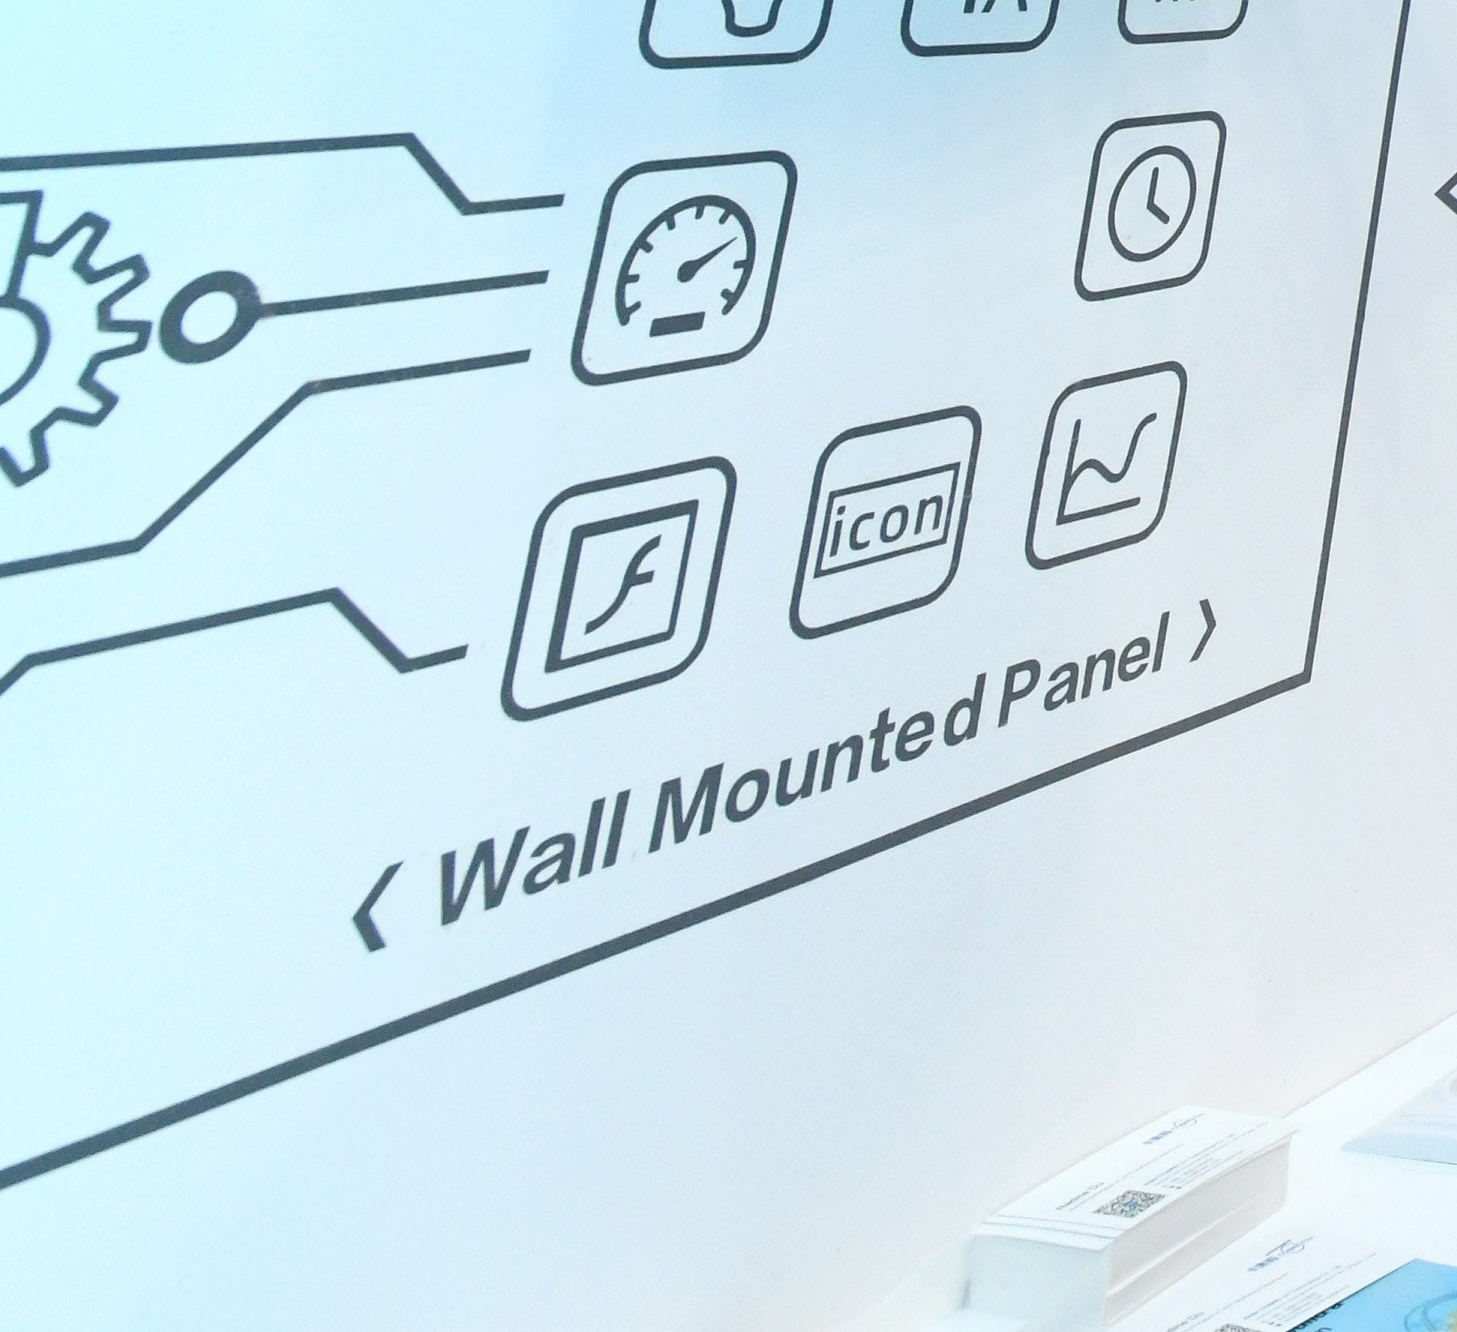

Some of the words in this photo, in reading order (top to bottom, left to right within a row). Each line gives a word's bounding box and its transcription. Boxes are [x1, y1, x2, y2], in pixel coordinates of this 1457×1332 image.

[827, 487, 944, 560] icon
[440, 788, 628, 927] Wall
[648, 670, 988, 854] Mounted
[996, 612, 1170, 729] Panel
